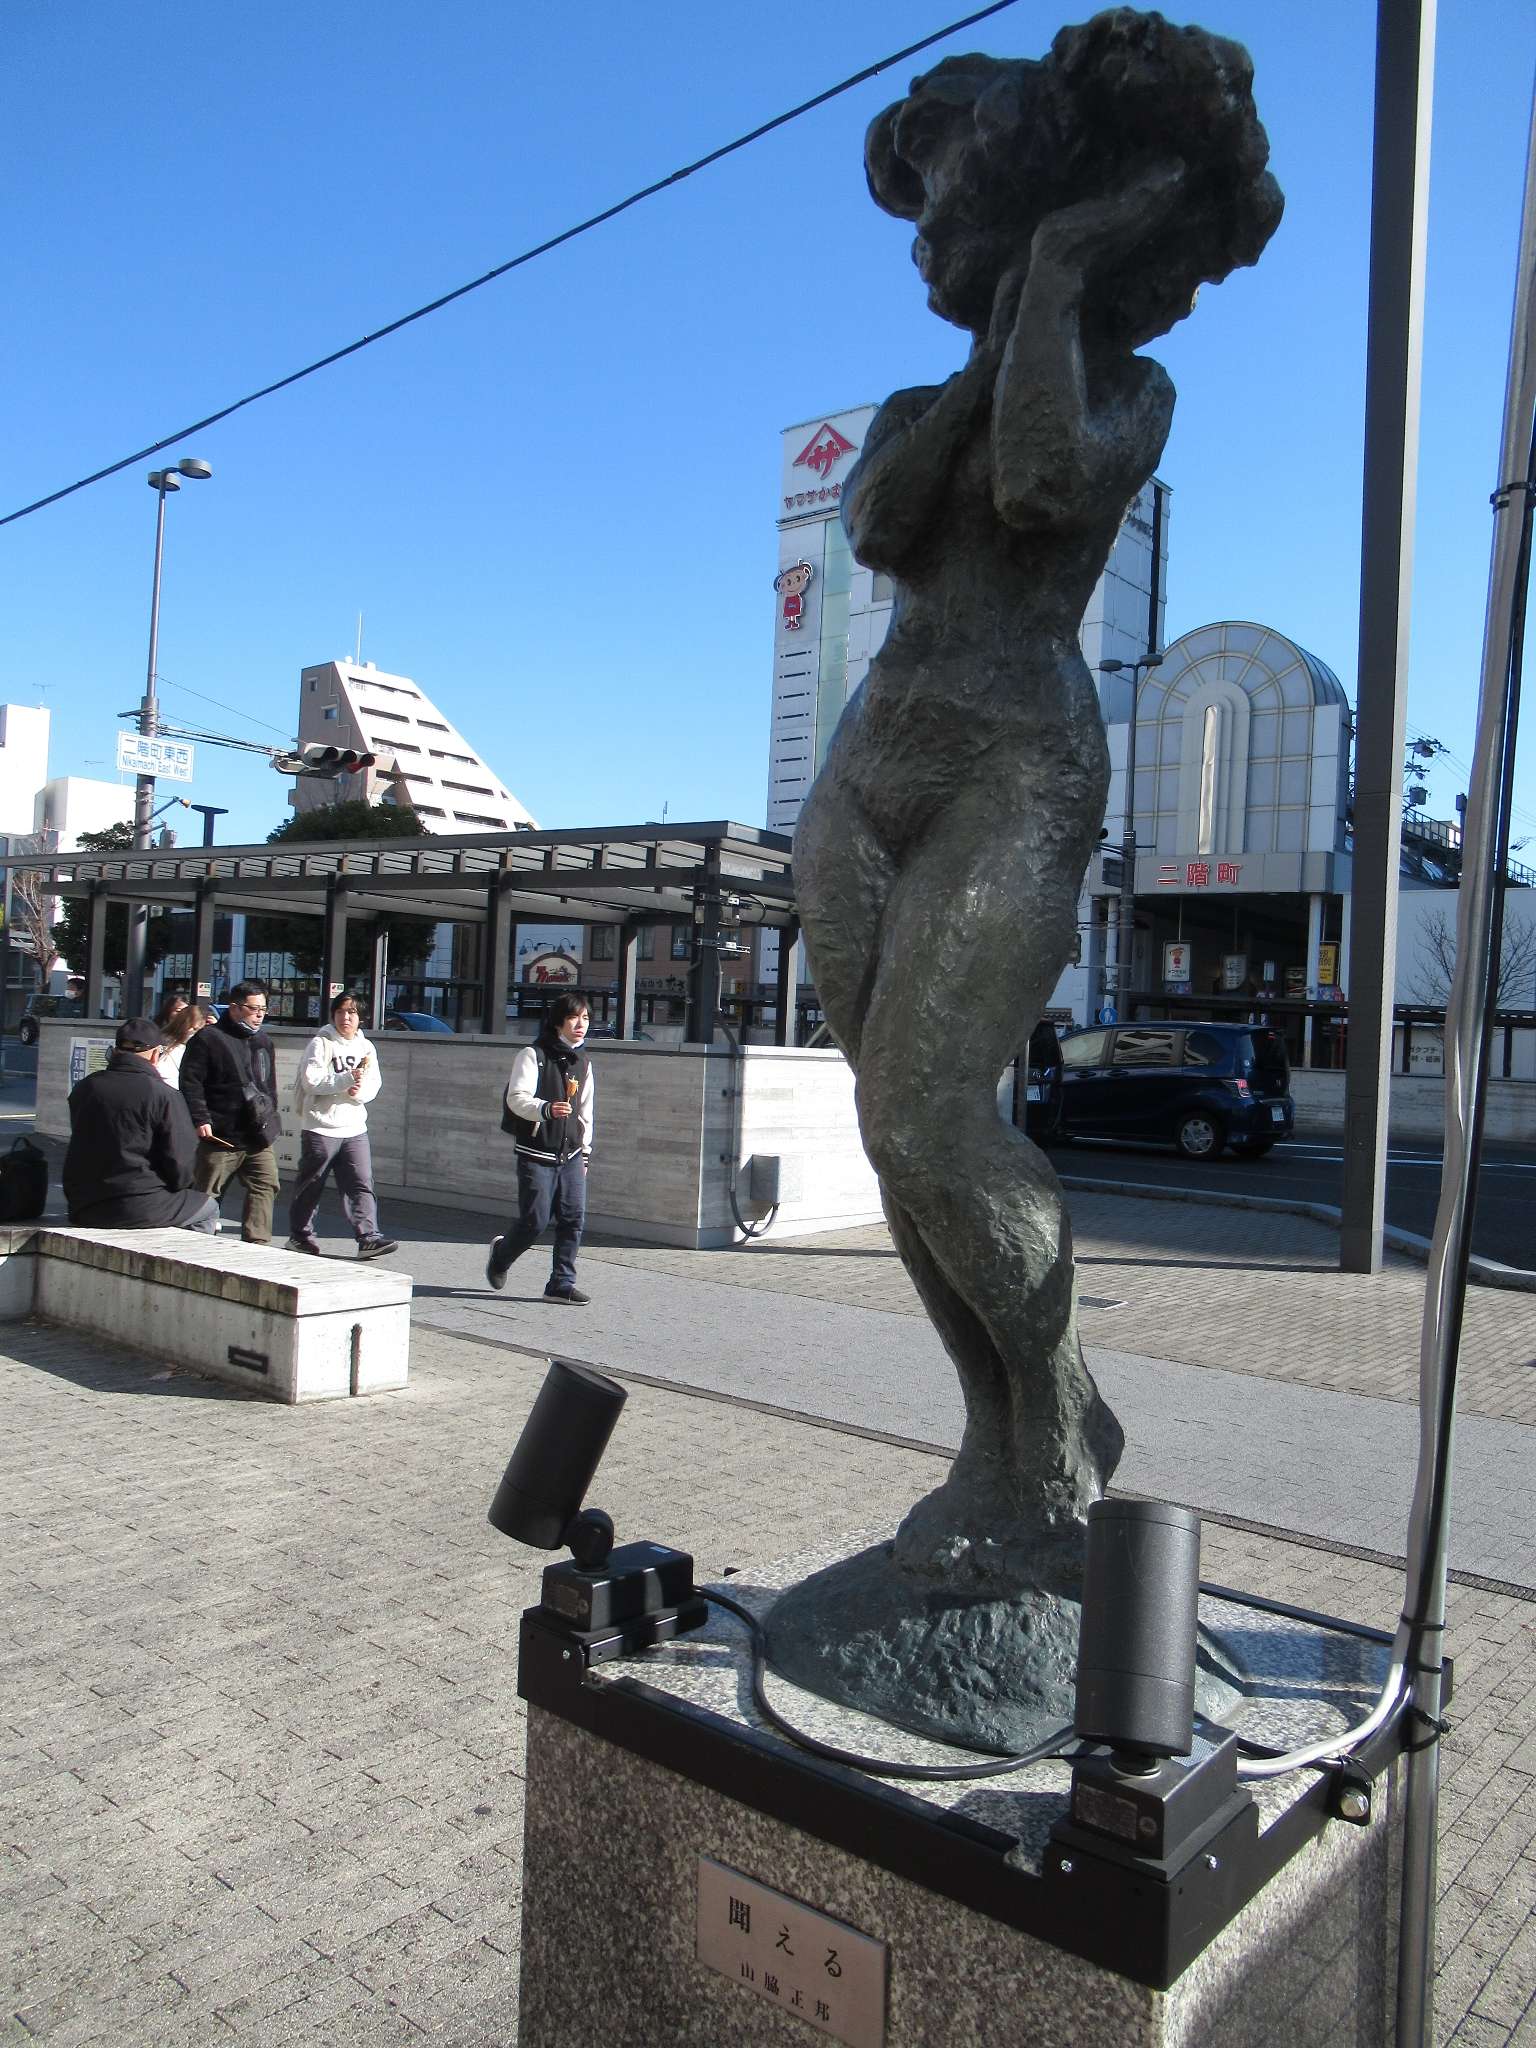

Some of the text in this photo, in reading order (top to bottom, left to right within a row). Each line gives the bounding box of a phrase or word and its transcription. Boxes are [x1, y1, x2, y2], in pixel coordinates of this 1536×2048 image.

[783, 482, 845, 511] ヤマサかま
[124, 739, 189, 765] 二階町東西
[158, 761, 172, 774] East
[174, 764, 189, 777] West
[1157, 862, 1242, 887] 二階町
[729, 1895, 842, 1978] 聞える
[741, 1959, 829, 2022] 山脇正邦
